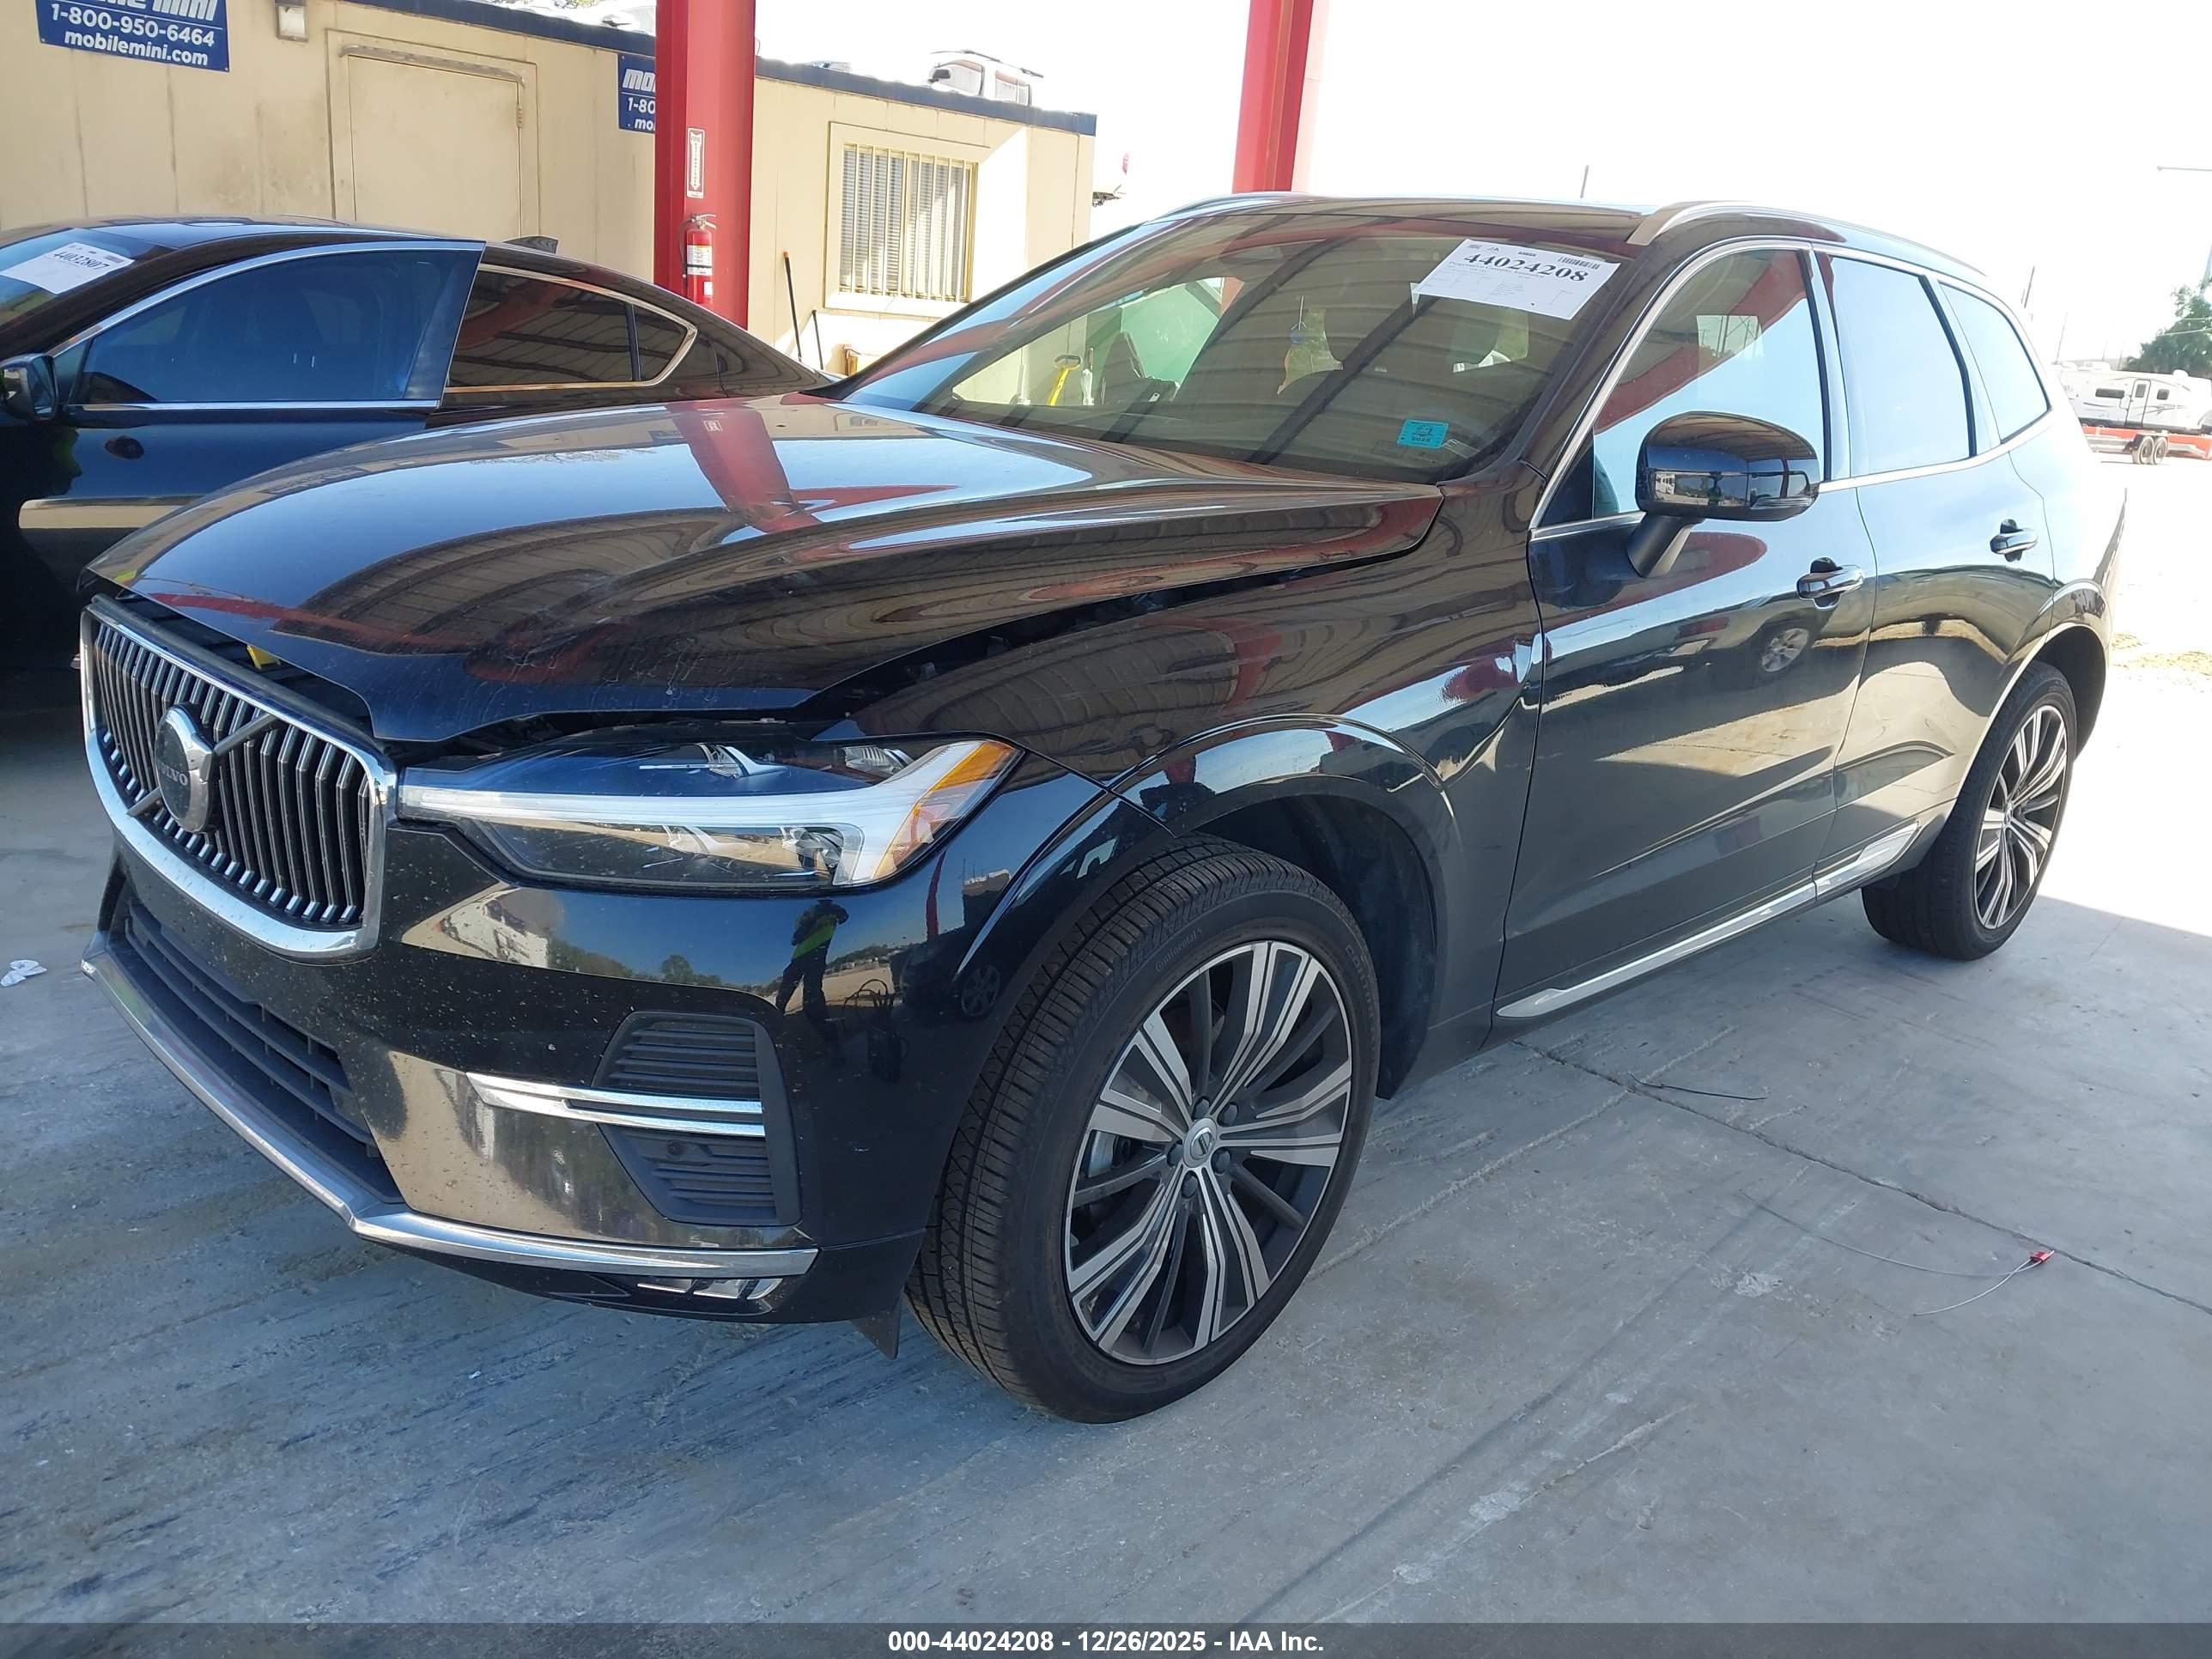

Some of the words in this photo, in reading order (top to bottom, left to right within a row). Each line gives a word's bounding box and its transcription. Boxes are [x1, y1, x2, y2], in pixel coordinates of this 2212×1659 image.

[51, 3, 215, 46] 1-800-950-6464
[64, 30, 208, 65] mobilemini.com
[623, 69, 656, 92] mo
[634, 118, 656, 131] mo
[1463, 254, 1589, 282] 44024208
